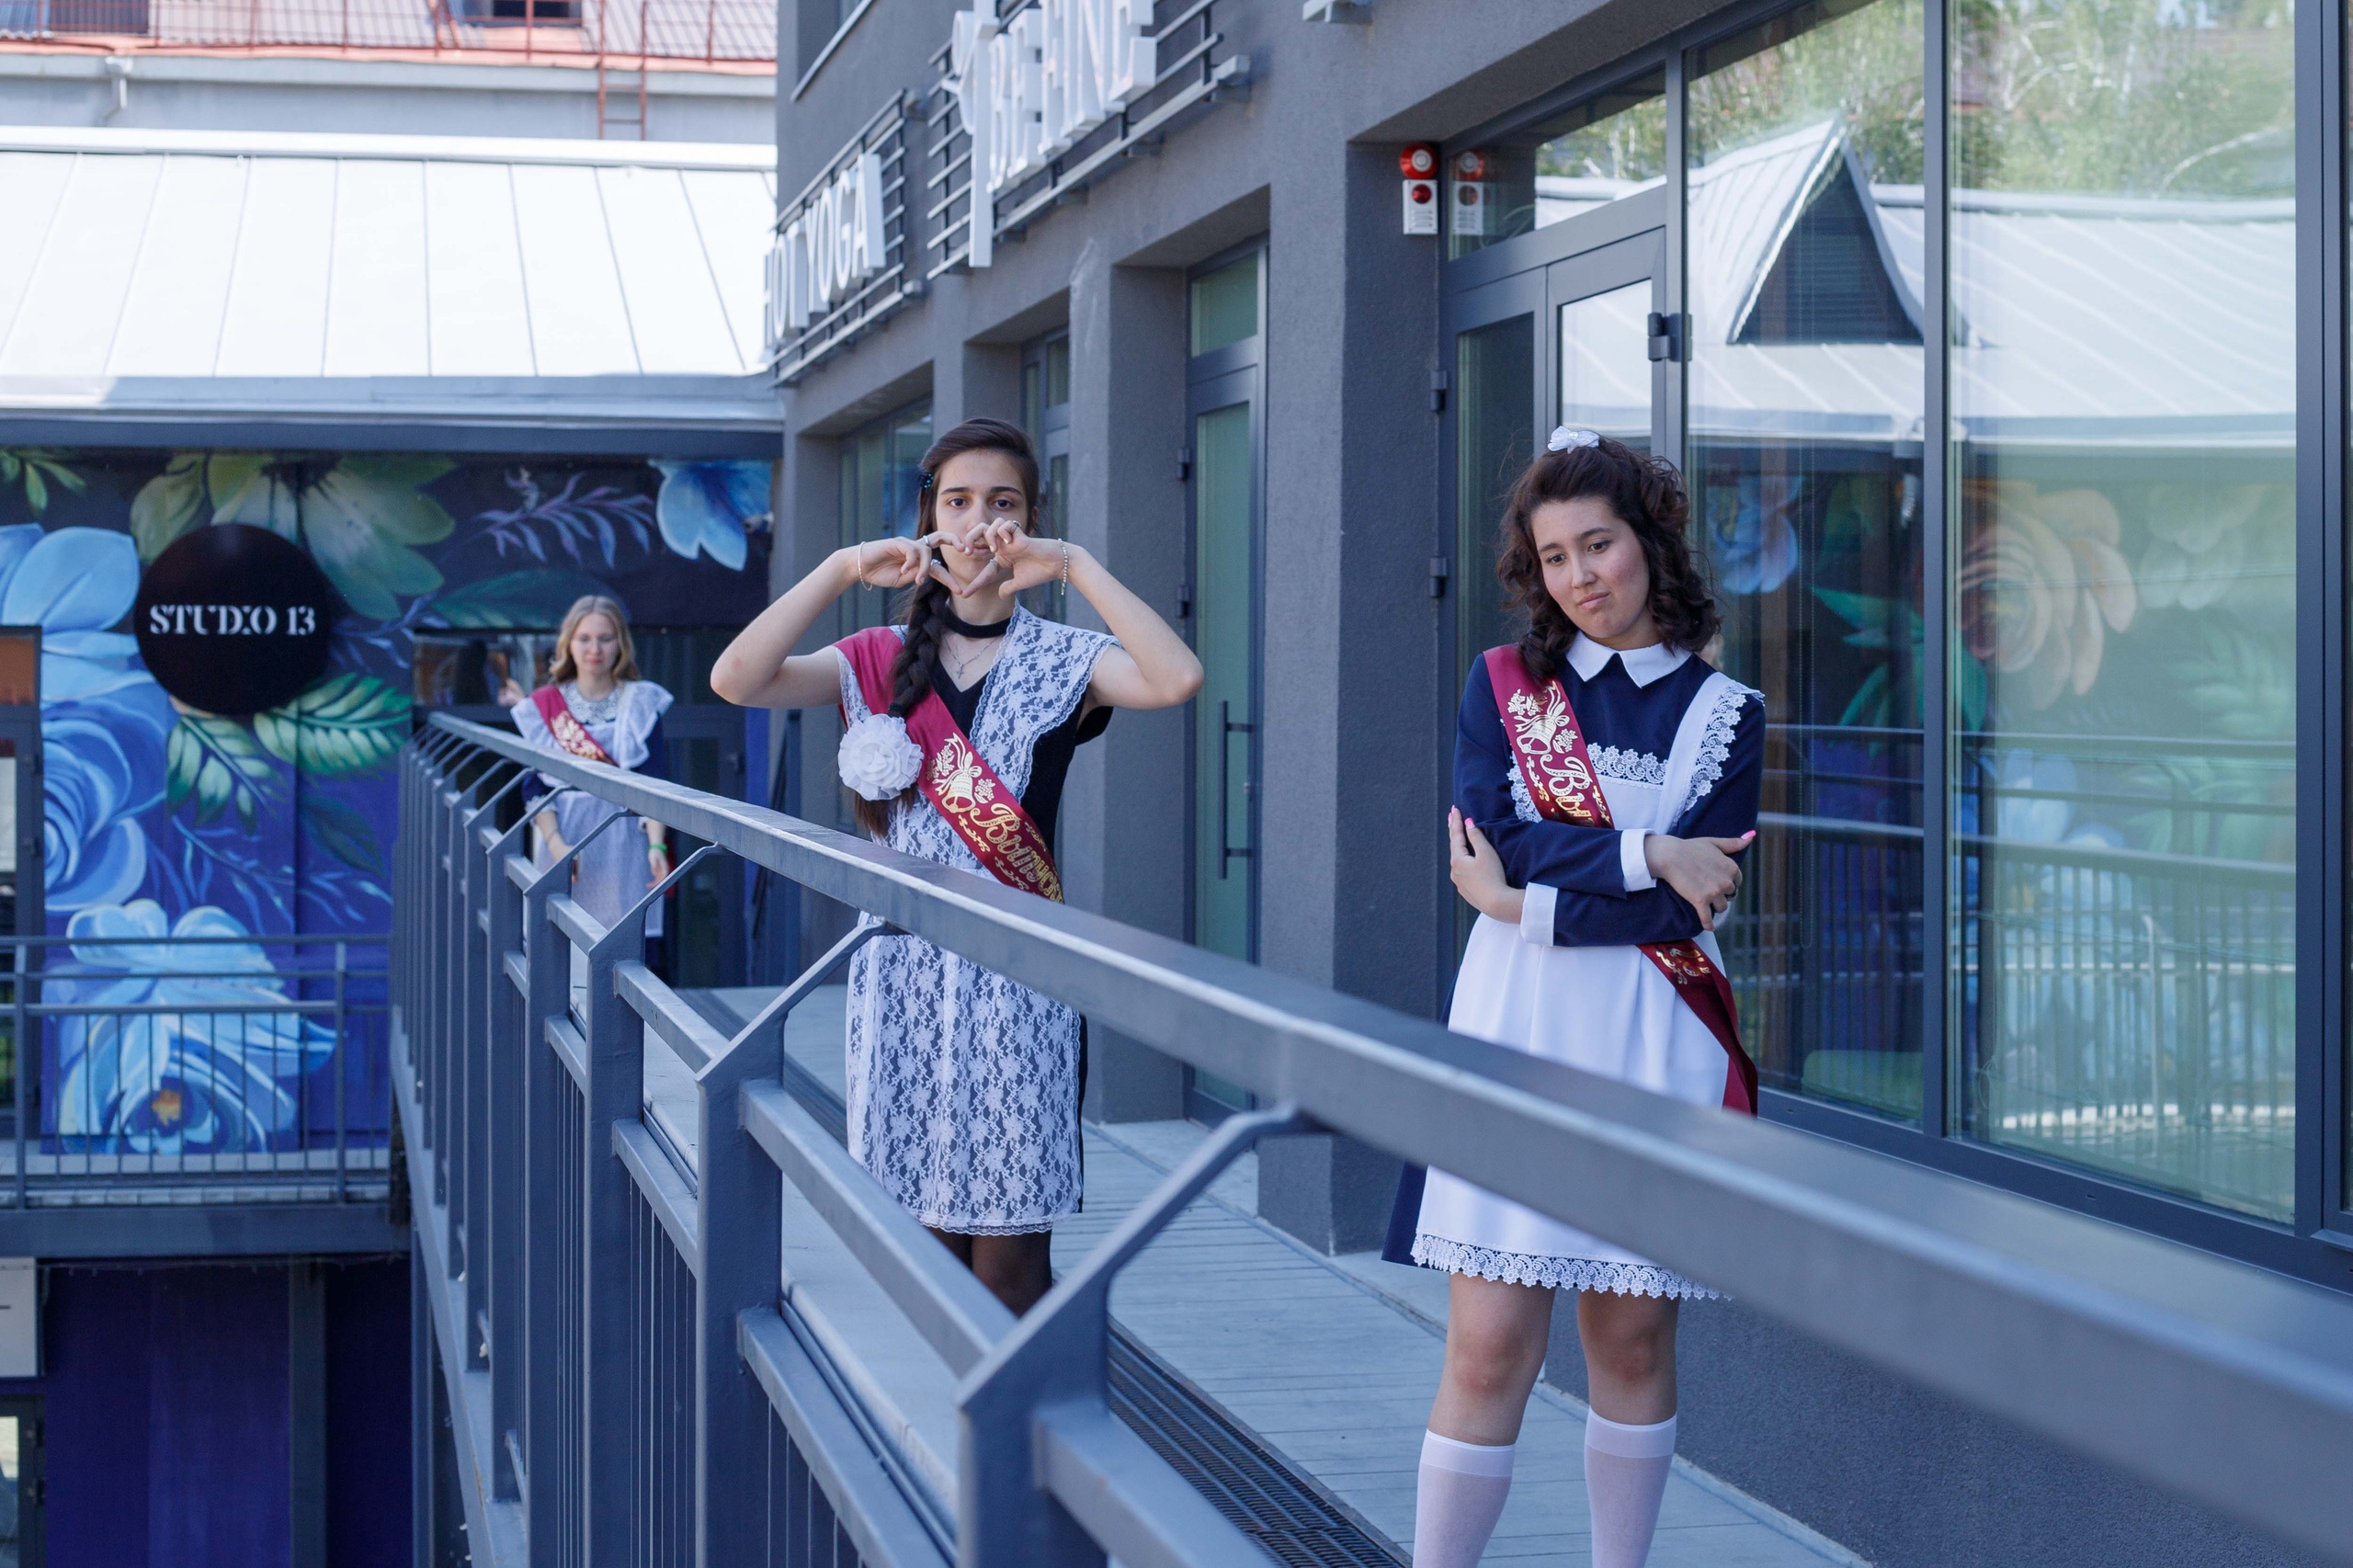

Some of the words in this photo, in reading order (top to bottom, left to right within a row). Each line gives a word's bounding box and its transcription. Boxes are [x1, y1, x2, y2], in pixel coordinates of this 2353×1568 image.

[804, 153, 887, 313] YOGA
[149, 604, 278, 635] STUDIO
[287, 605, 316, 636] 13
